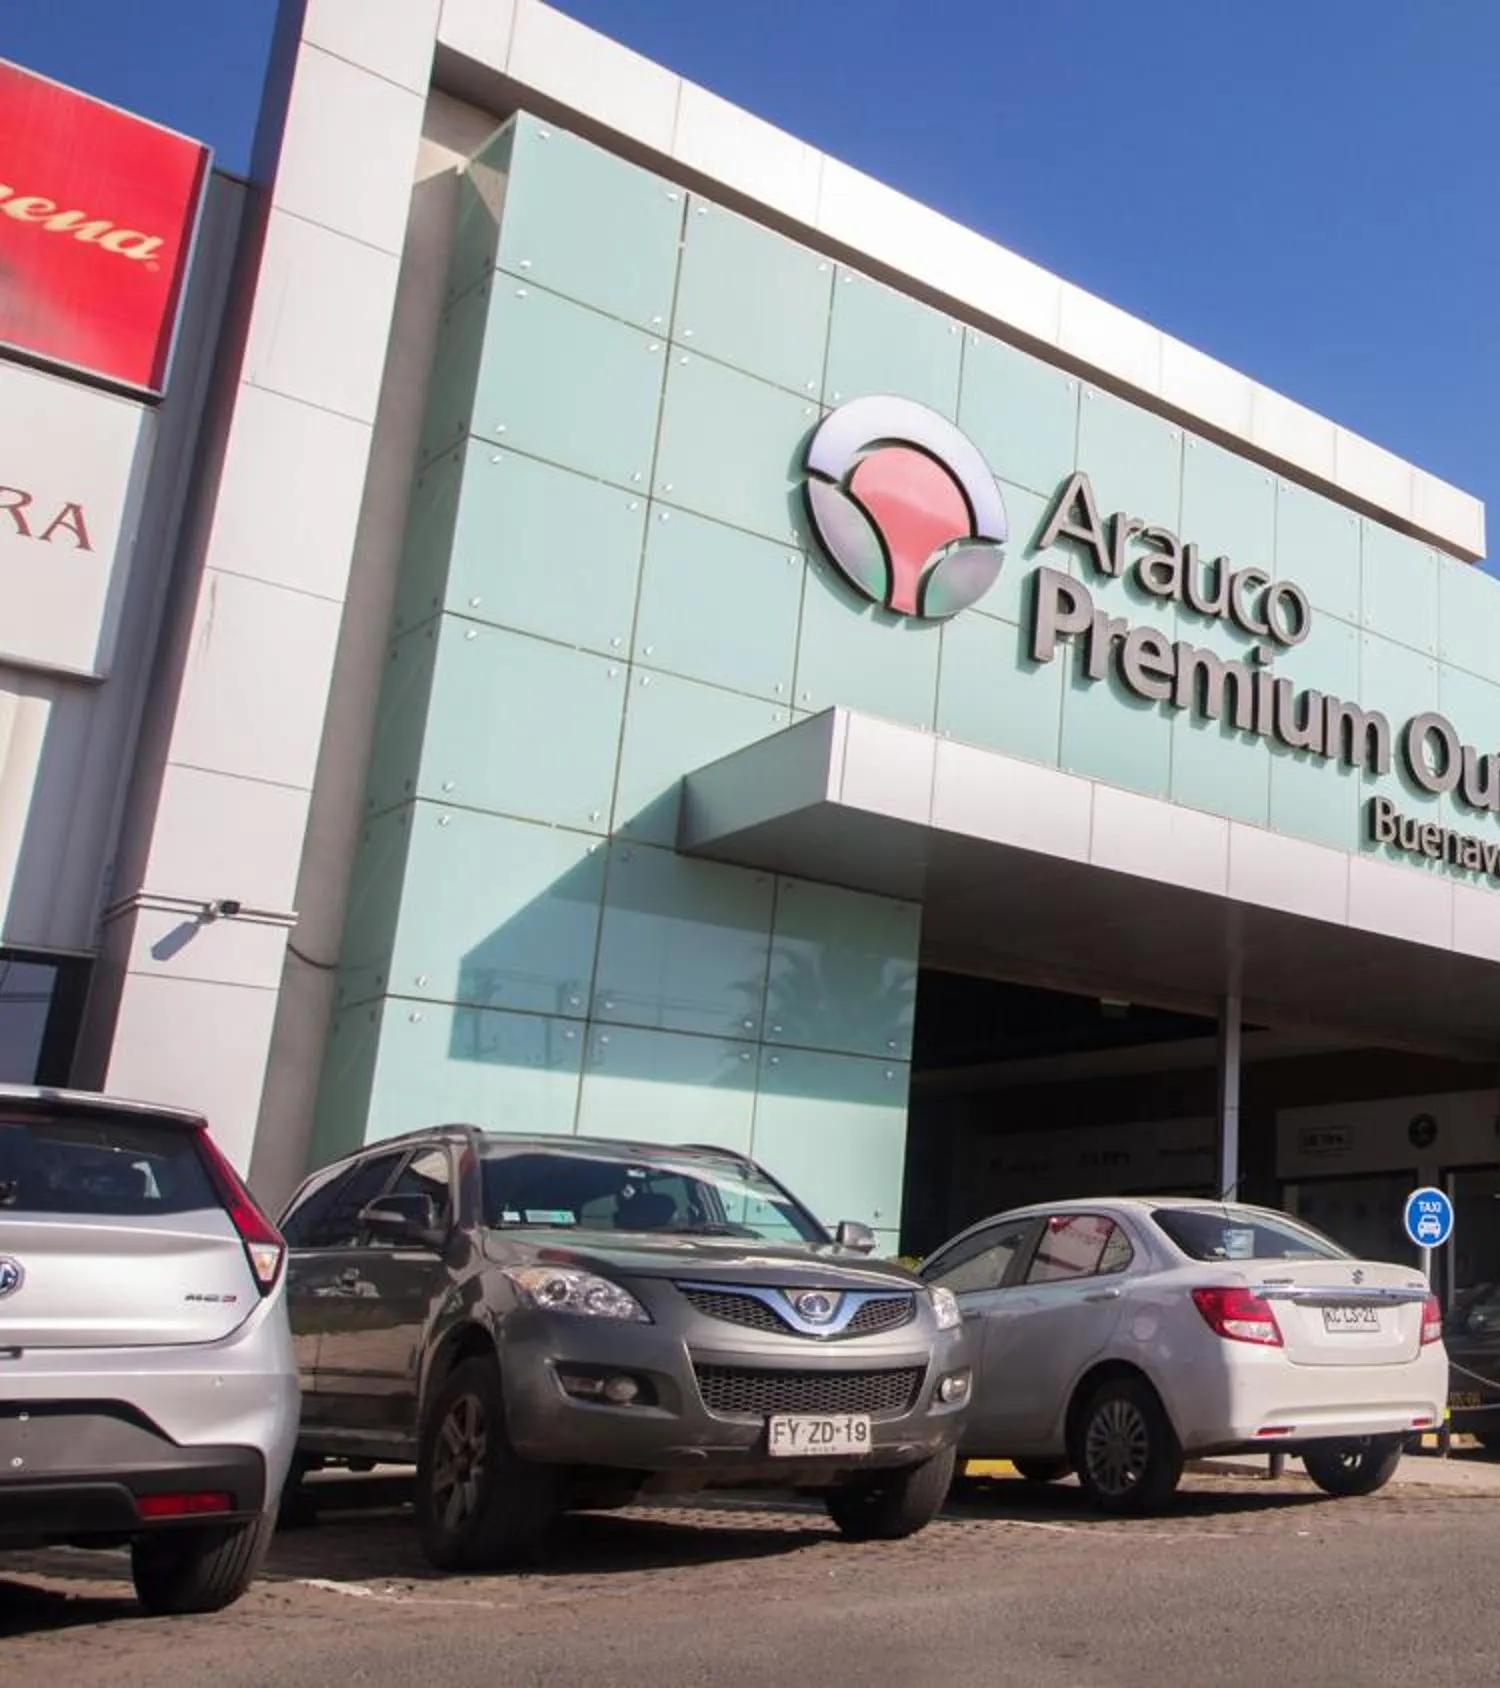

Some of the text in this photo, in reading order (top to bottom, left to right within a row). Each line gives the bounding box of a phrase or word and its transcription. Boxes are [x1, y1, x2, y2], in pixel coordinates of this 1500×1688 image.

[1038, 471, 1311, 647] Arauco
[1030, 565, 1391, 776] Premium
[1418, 1200, 1443, 1213] TAXI
